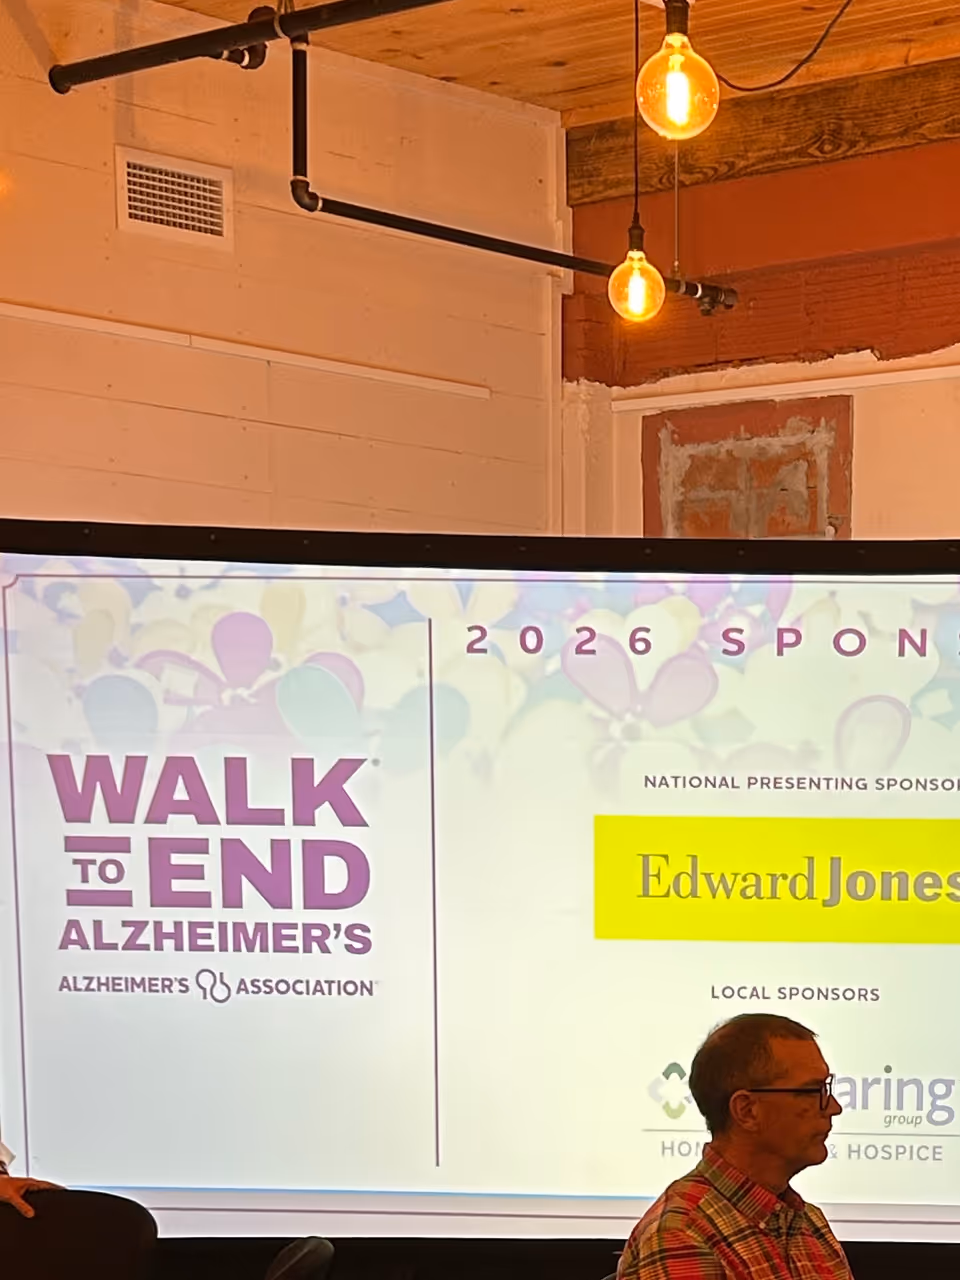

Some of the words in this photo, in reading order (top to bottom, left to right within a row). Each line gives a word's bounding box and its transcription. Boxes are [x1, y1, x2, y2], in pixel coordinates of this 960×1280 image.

[466, 625, 652, 655] 2026
[46, 754, 370, 827] WALK
[644, 774, 740, 789] NATIONAL
[747, 776, 868, 791] PRESENTING
[72, 858, 126, 885] TO
[148, 837, 370, 910] END
[58, 918, 372, 955] ALZHEIMER'S
[58, 975, 190, 995] ALZHEIMER'S
[236, 977, 375, 998] ASSOCIATION
[711, 985, 772, 1000] LOCAL
[777, 987, 881, 1002] SPONSORS
[833, 1064, 956, 1127] aring
[883, 1114, 923, 1128] group
[847, 1143, 943, 1161] HOSPICE
